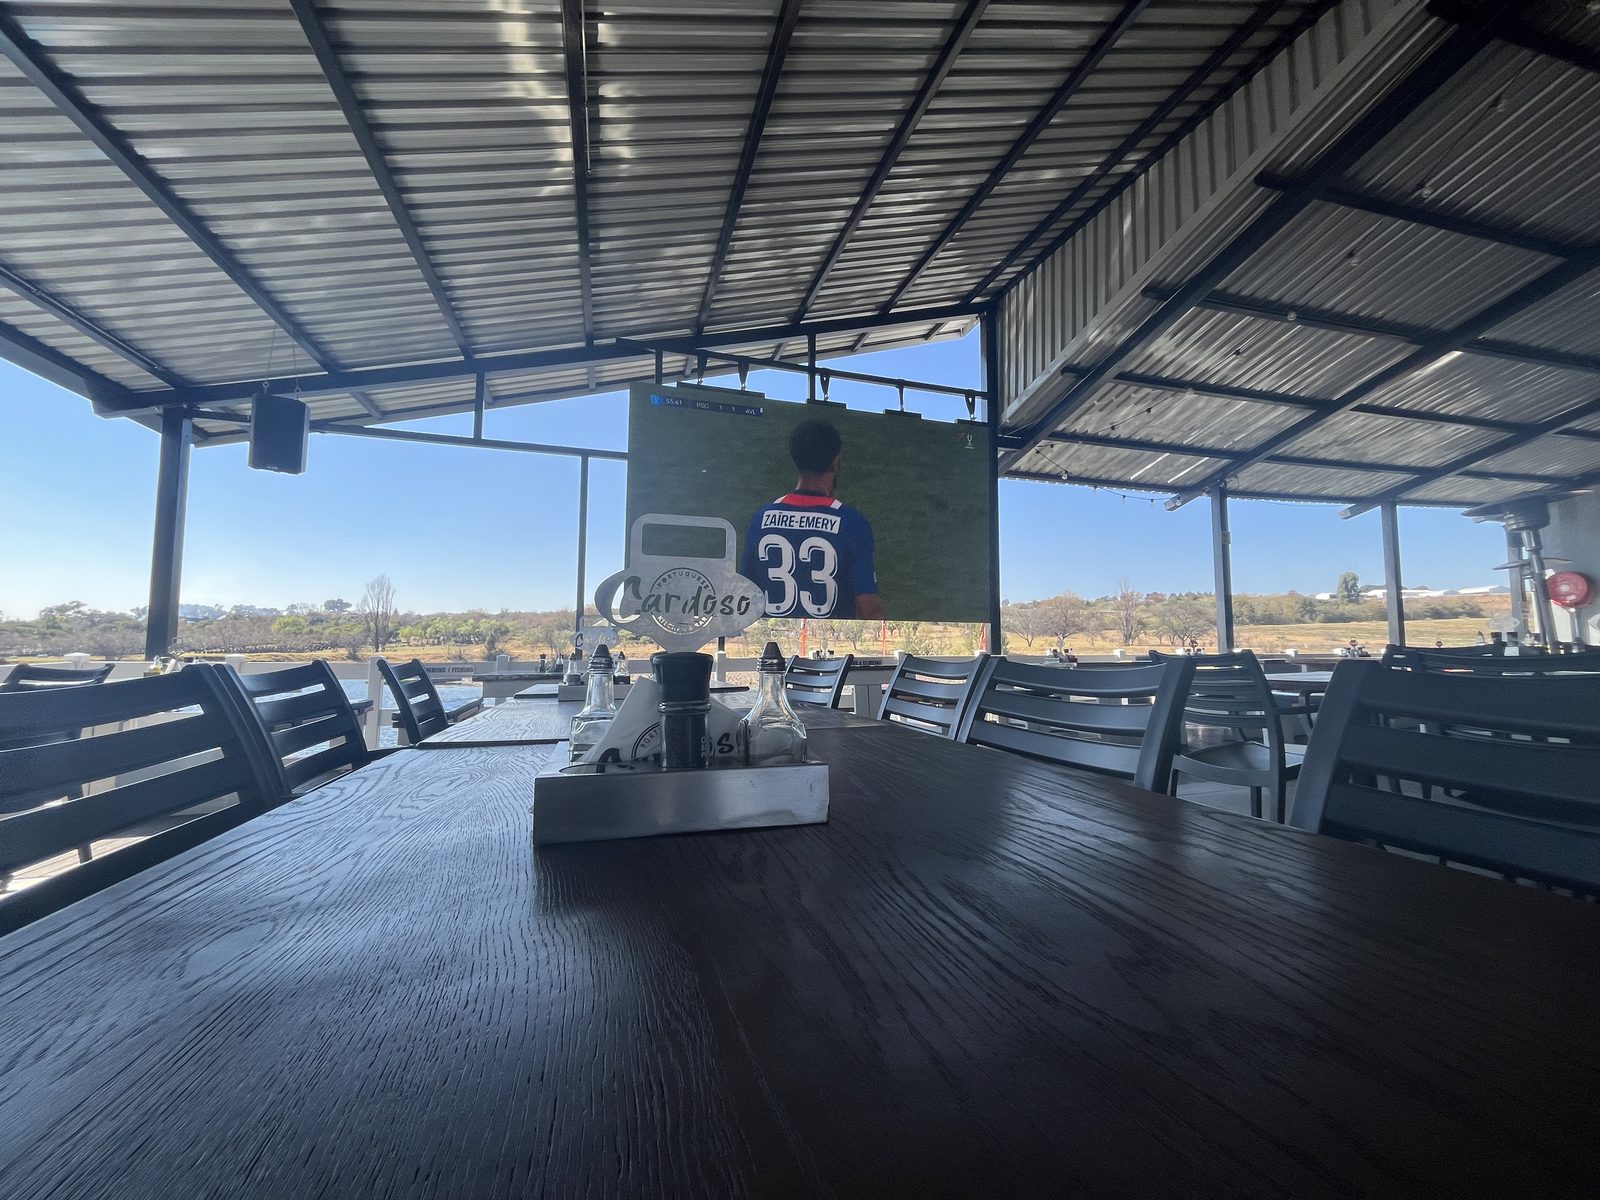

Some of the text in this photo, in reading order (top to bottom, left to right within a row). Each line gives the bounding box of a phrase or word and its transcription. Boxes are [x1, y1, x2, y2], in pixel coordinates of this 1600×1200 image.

[763, 512, 838, 531] ZAÏRE-EMERY
[611, 575, 751, 623] Cardoso
[758, 533, 838, 619] 33
